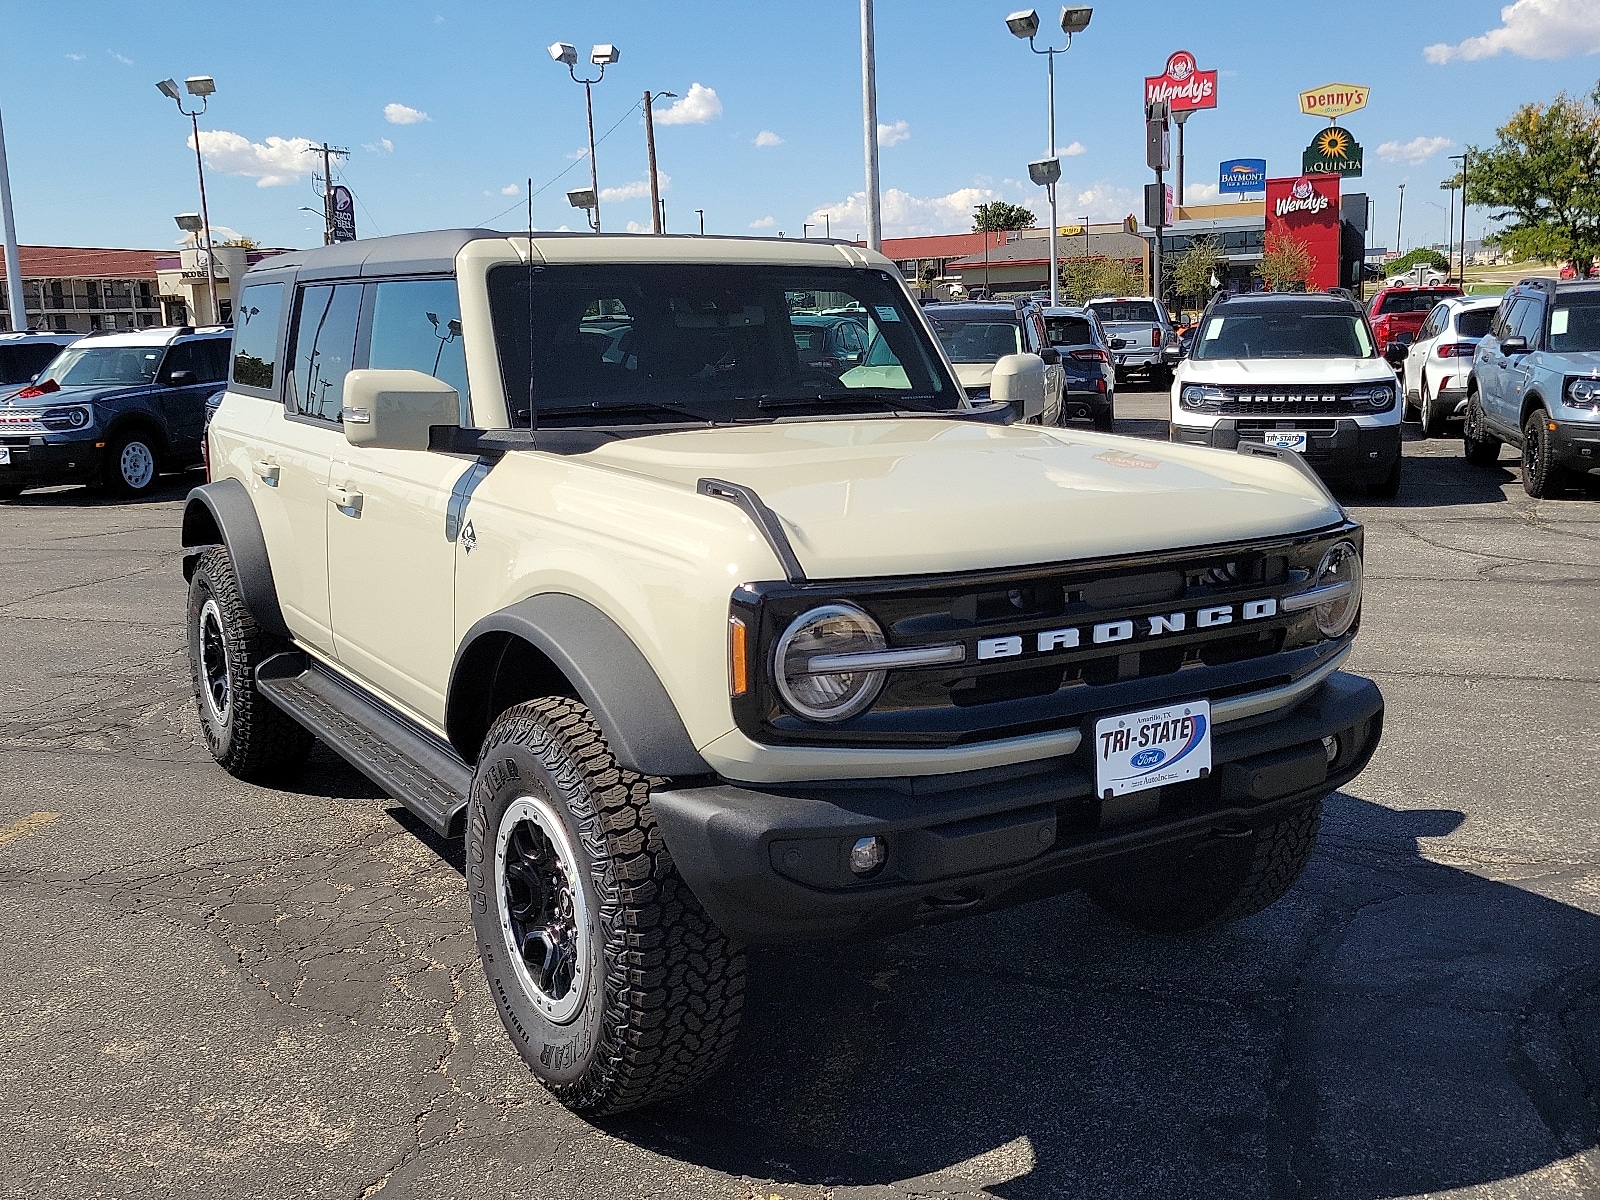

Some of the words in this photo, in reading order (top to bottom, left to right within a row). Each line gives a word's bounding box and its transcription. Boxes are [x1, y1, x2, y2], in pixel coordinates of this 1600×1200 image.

[1147, 76, 1213, 104] Wendy's
[1306, 90, 1363, 109] Denny's
[1221, 173, 1264, 182] BAYMONT
[1314, 160, 1361, 174] QUINTA
[1276, 194, 1329, 217] Wendy's
[977, 598, 1277, 660] BRONCO
[1100, 716, 1191, 762] TRI-STATE
[1137, 751, 1159, 766] Ford
